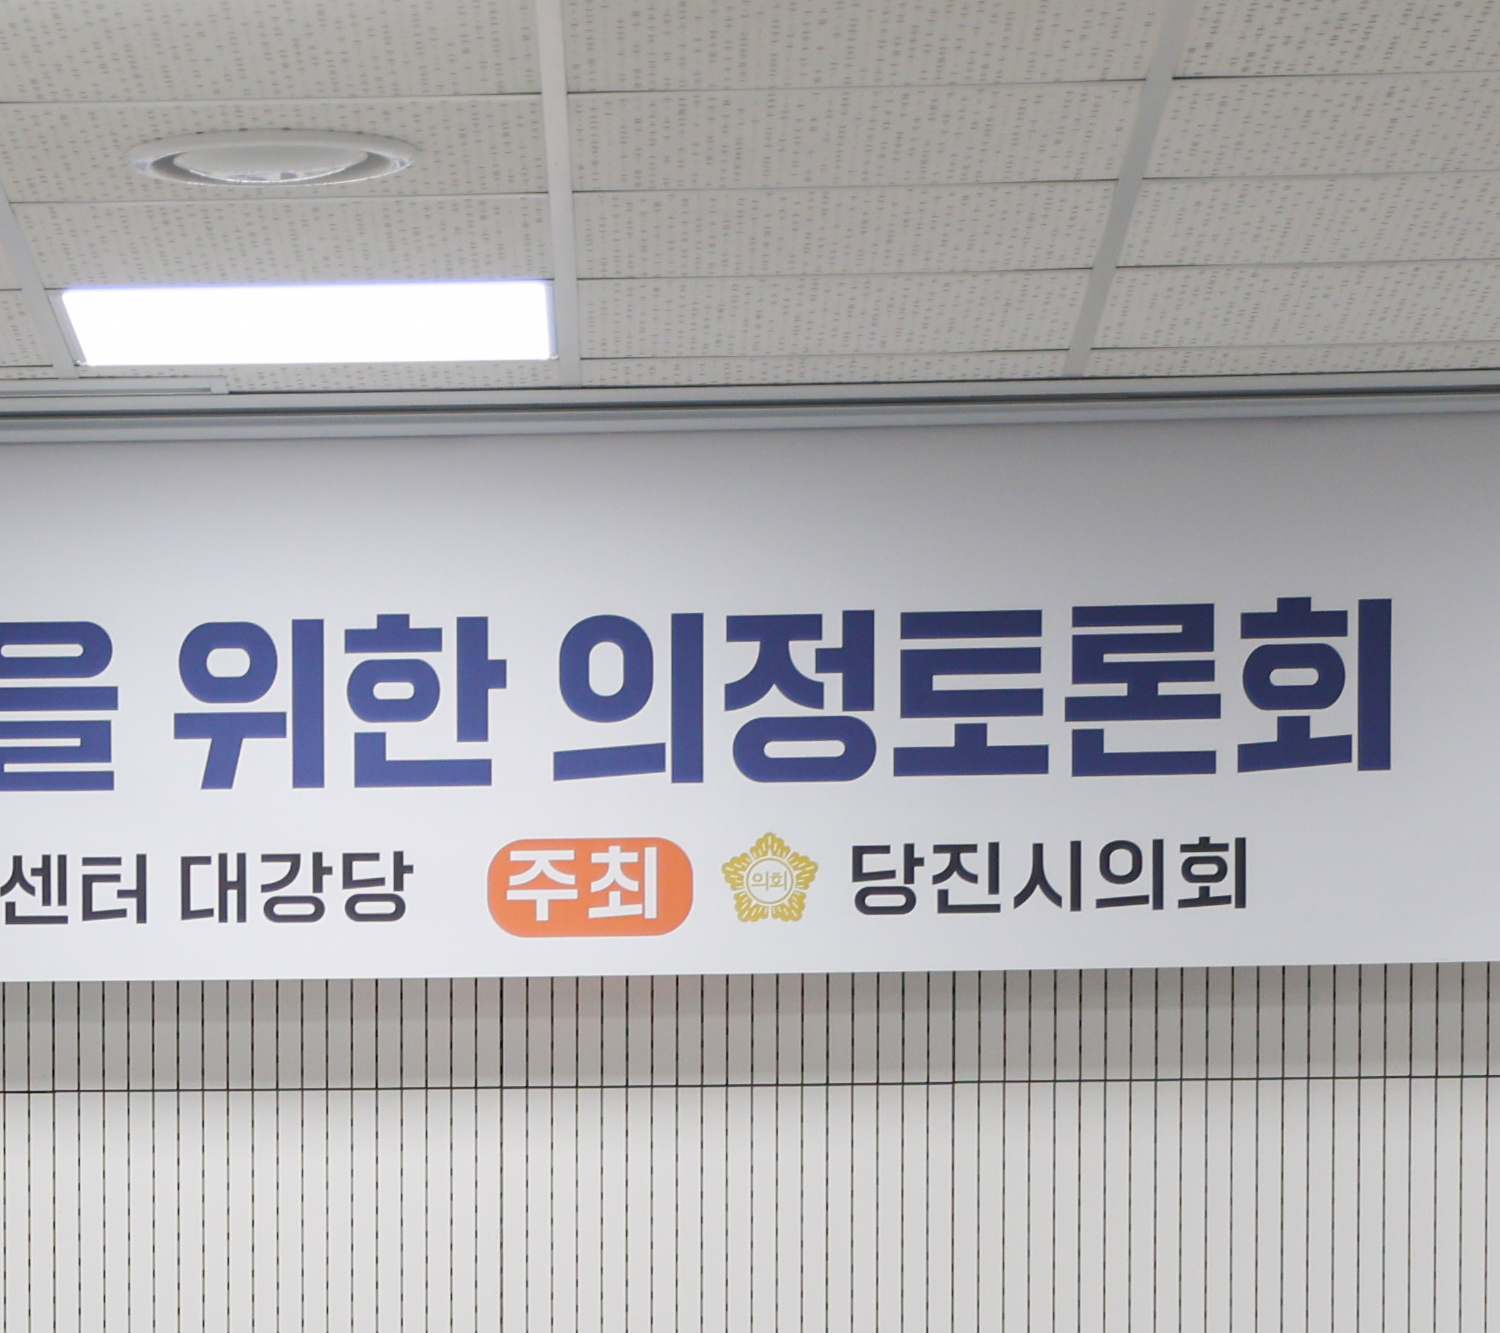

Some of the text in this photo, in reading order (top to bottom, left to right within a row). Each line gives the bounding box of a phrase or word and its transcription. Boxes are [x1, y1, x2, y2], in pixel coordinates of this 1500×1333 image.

[174, 613, 507, 789] 위한
[553, 596, 1393, 784] 의정토론회
[180, 850, 414, 925] 대강당
[504, 844, 658, 919] 주최
[751, 870, 788, 892] 의회
[851, 836, 1248, 915] 당진시의회
